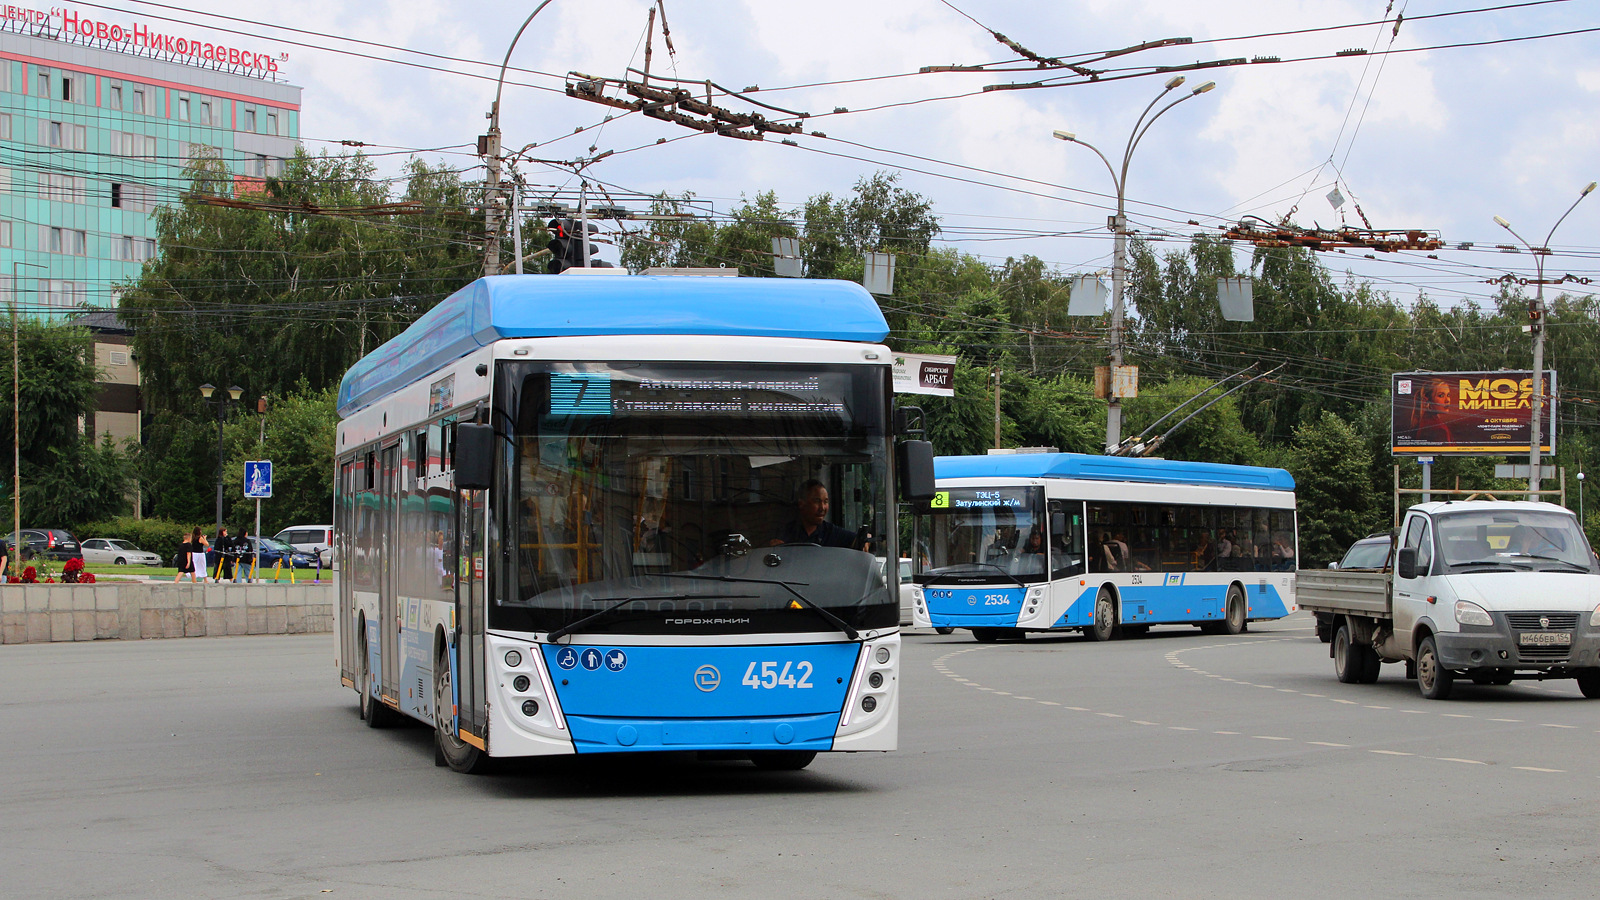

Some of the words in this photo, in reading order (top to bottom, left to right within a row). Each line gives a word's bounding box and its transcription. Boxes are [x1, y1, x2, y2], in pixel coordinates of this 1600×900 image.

[924, 373, 948, 385] АРБАТ
[571, 380, 589, 407] 7
[1458, 399, 1545, 410] МИШЕЛ
[935, 494, 943, 506] 8
[975, 491, 1000, 499] ТЭЦ-5
[955, 499, 1001, 508] Затулинский
[984, 594, 1011, 606] 2534
[665, 617, 750, 625] ГОРОЖАНИН
[742, 661, 814, 690] 4542
